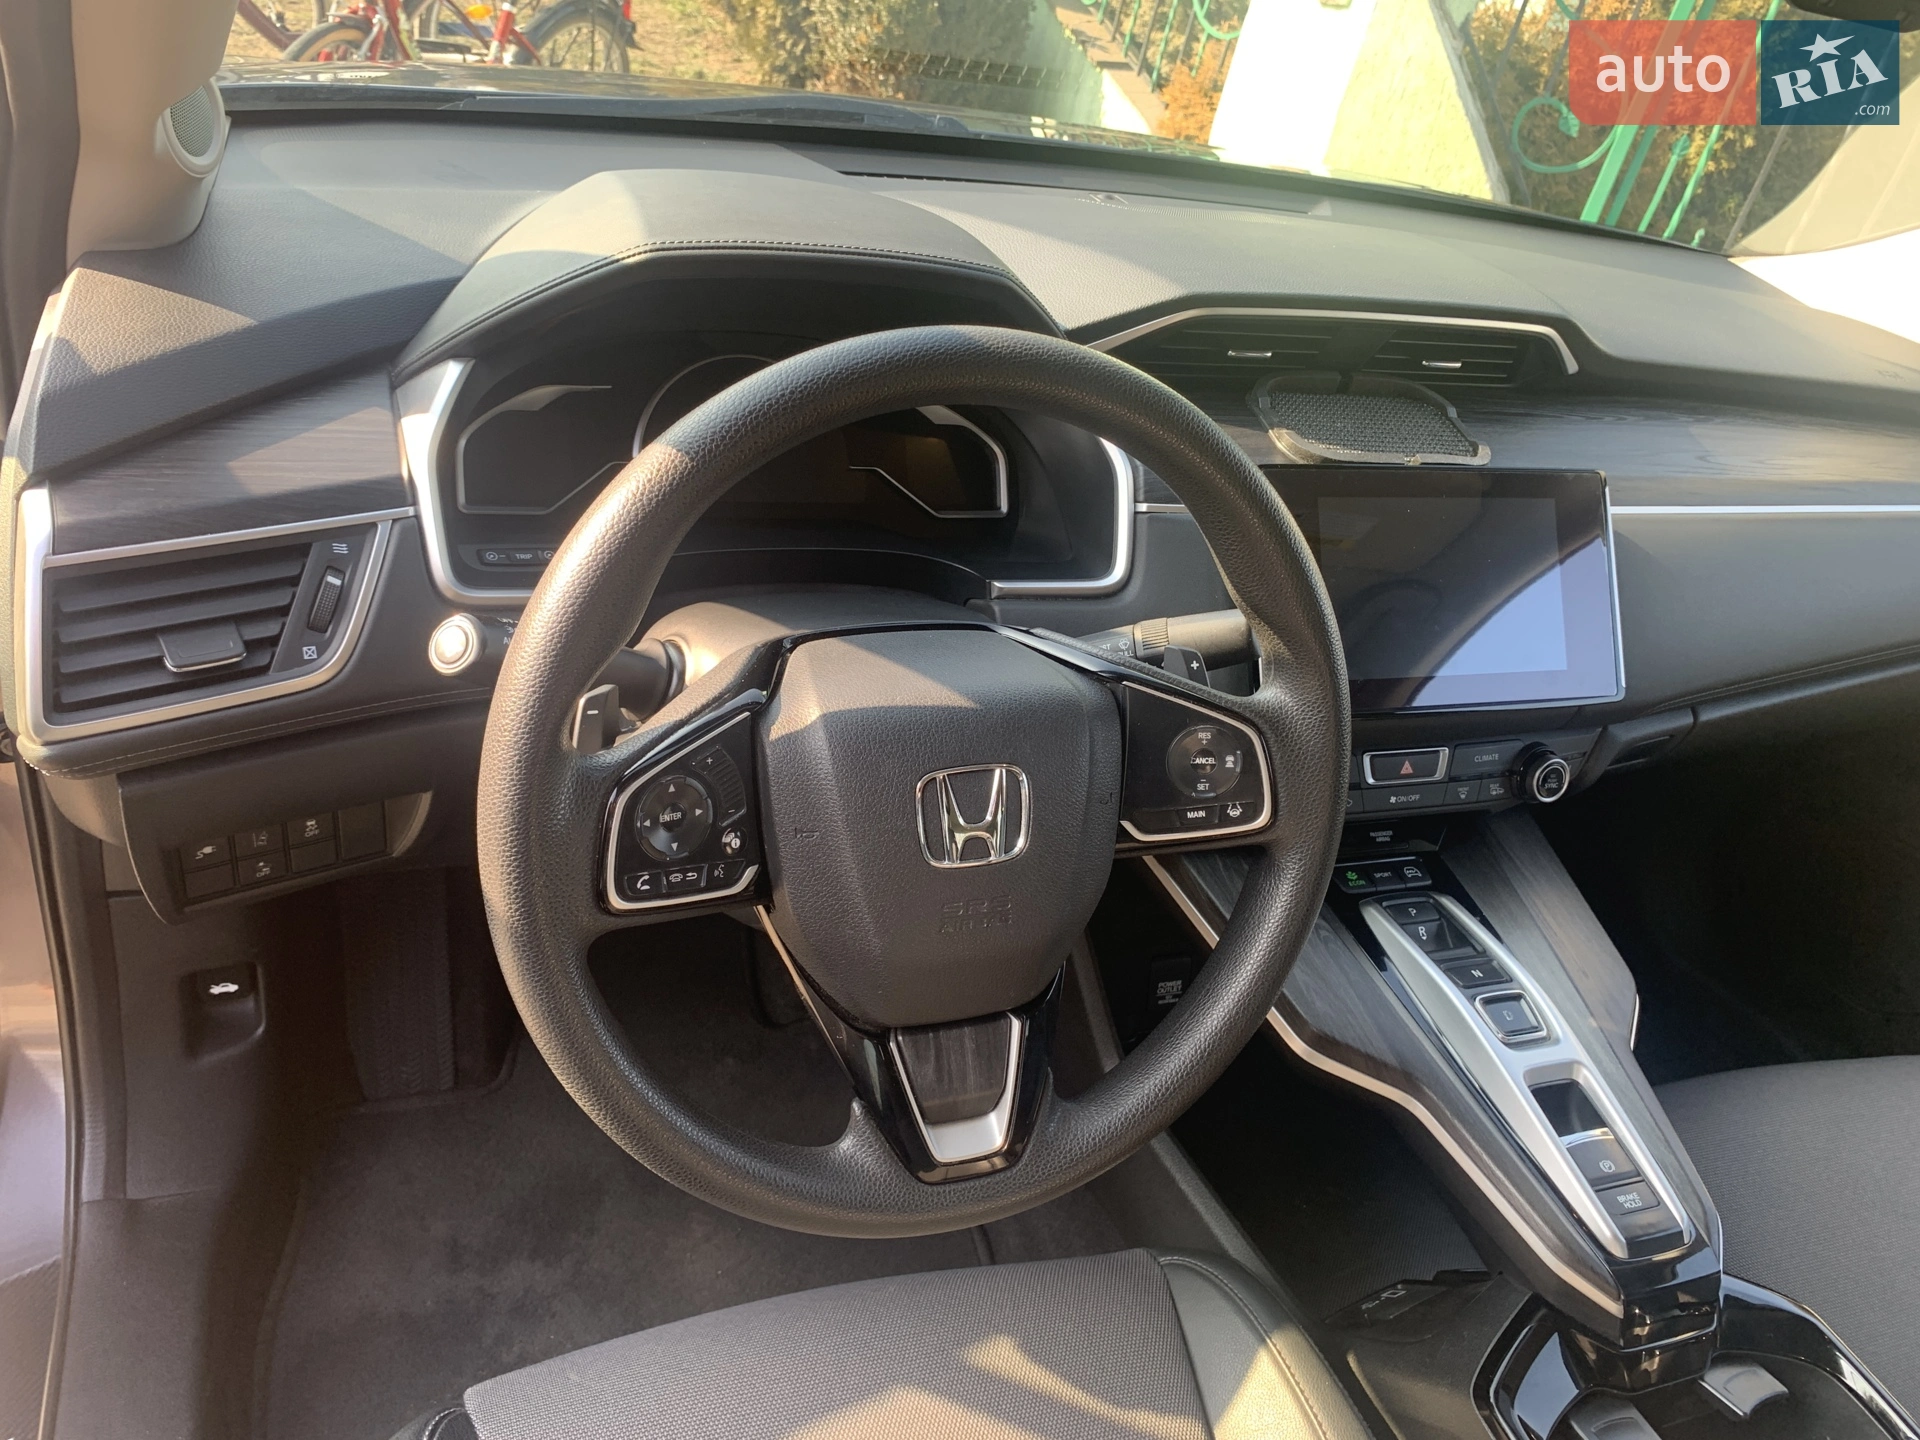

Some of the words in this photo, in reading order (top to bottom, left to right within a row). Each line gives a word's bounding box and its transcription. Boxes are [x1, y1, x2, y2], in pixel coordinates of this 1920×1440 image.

[1474, 753, 1499, 763] CLIMATE
[1197, 783, 1210, 791] SET
[660, 811, 682, 823] ENTER
[1187, 810, 1206, 819] MAIN
[305, 828, 320, 838] OFF
[256, 868, 271, 878] OFF
[1408, 907, 1417, 917] P
[1418, 926, 1427, 936] R
[1471, 969, 1484, 978] N
[1616, 1192, 1640, 1203] BRAKE
[1623, 1199, 1642, 1209] HOLD
